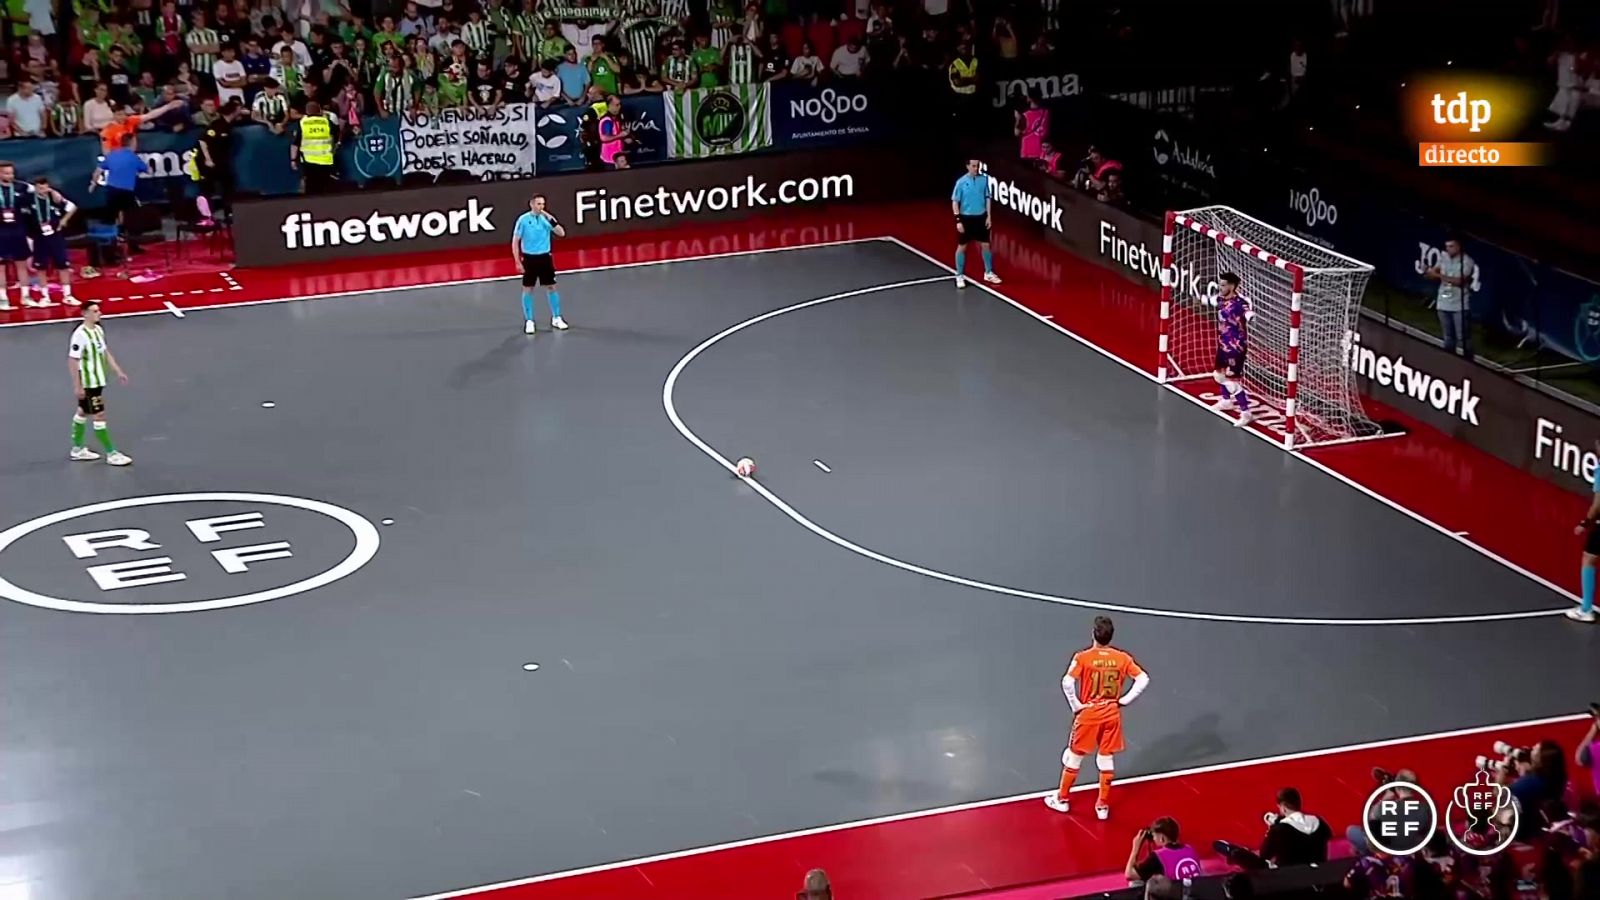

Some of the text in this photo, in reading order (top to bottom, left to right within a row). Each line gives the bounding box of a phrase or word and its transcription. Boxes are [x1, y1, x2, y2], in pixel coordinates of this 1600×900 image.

[281, 198, 496, 249] finetwork
[575, 173, 854, 224] Finetwork.com
[1535, 417, 1599, 484] Fine
[1091, 670, 1120, 699] 15
